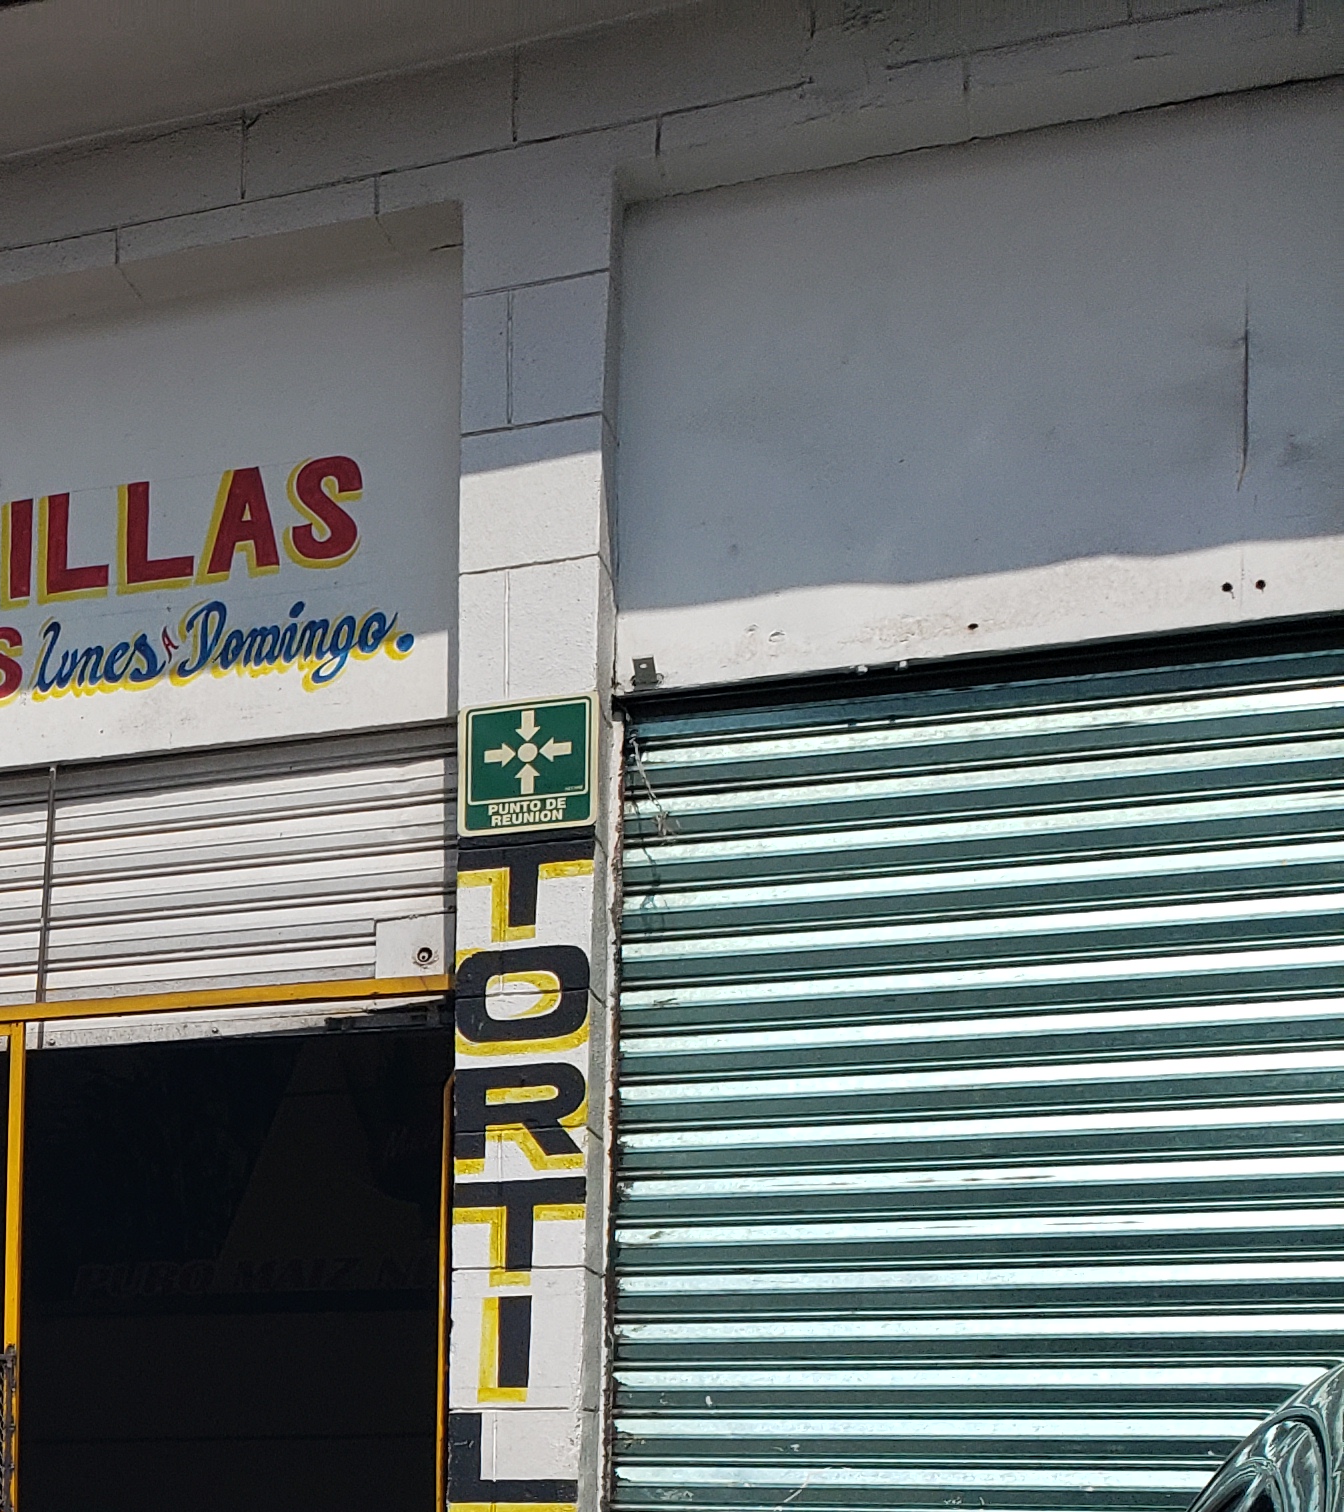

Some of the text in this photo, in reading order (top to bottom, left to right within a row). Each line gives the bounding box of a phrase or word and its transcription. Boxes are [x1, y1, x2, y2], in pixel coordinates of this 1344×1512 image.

[488, 797, 567, 816] PUNTO DE
[491, 809, 563, 827] REUNION
